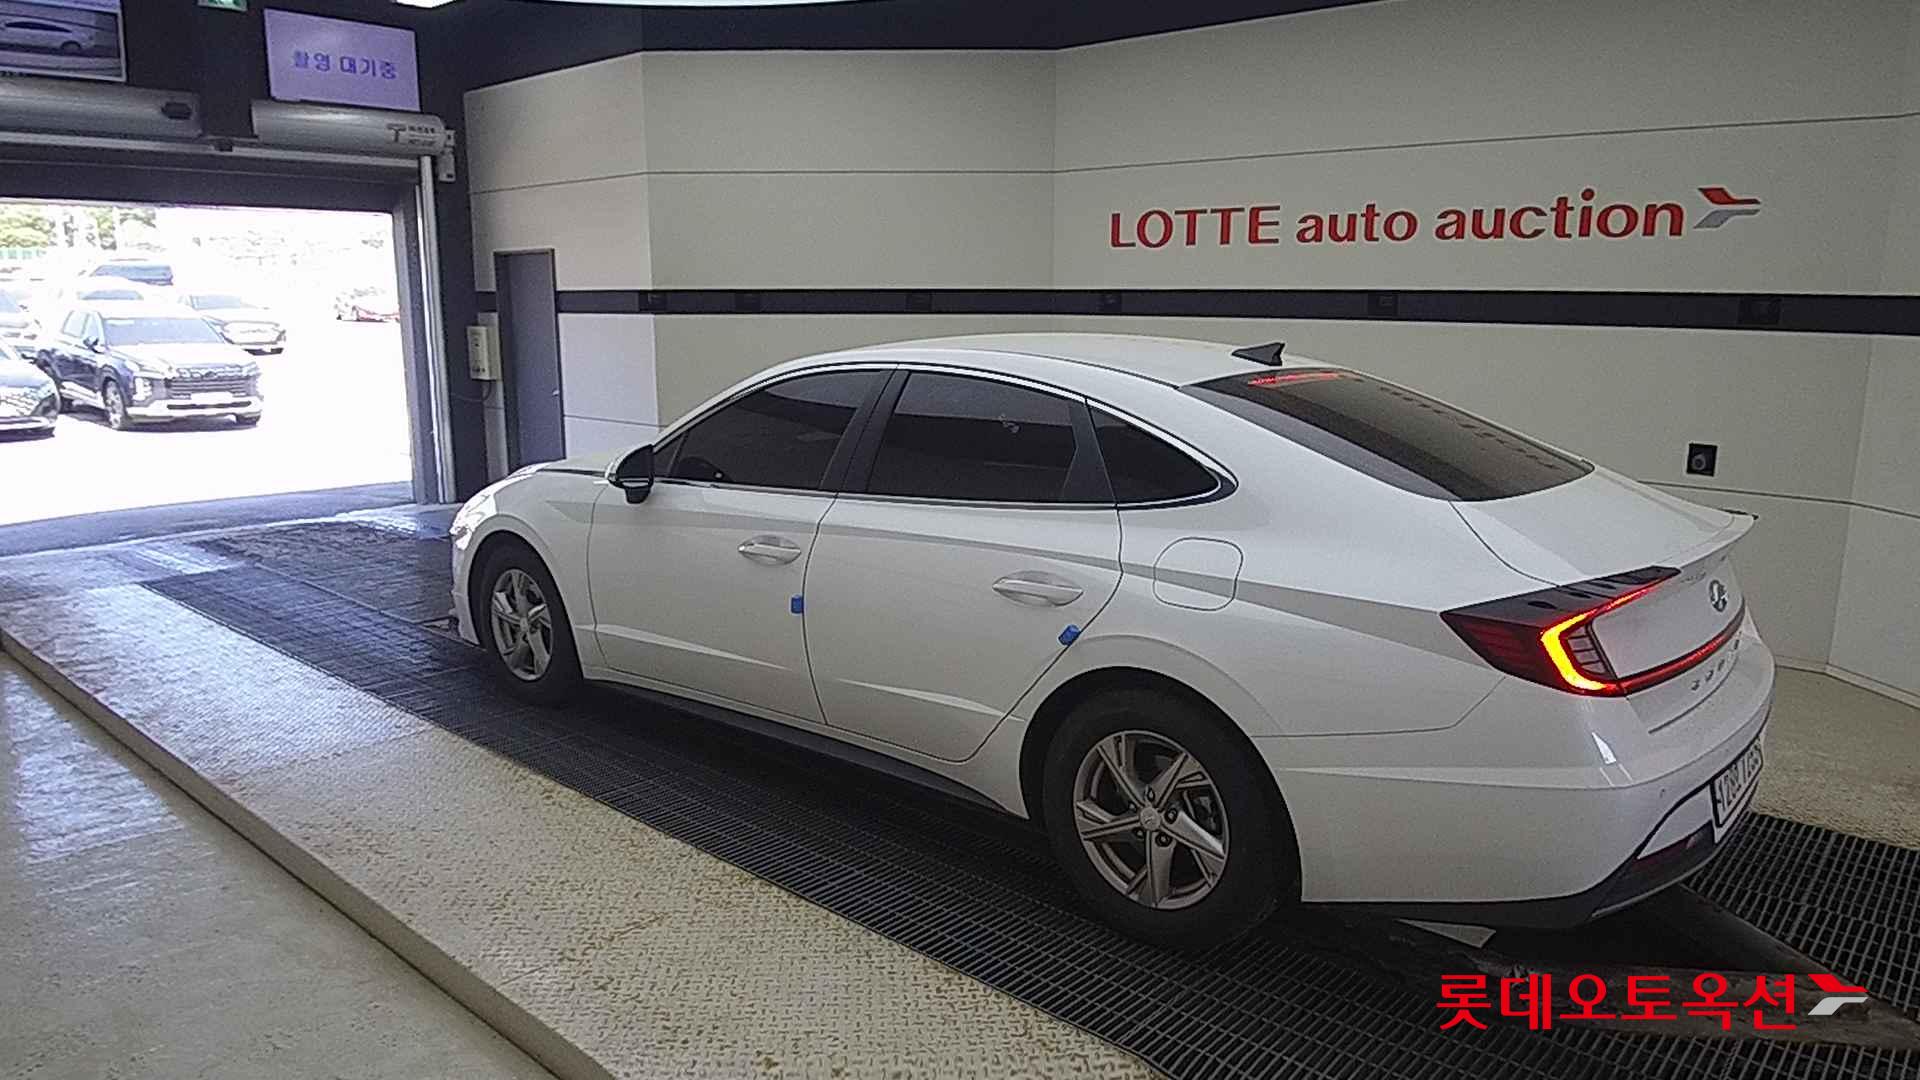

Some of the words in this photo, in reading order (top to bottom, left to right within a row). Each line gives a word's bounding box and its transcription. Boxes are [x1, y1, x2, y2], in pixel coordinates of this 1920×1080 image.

[339, 55, 398, 81] 대기중
[1110, 206, 1280, 249] LOTTE
[1296, 203, 1418, 243] auto
[1434, 187, 1685, 239] auction
